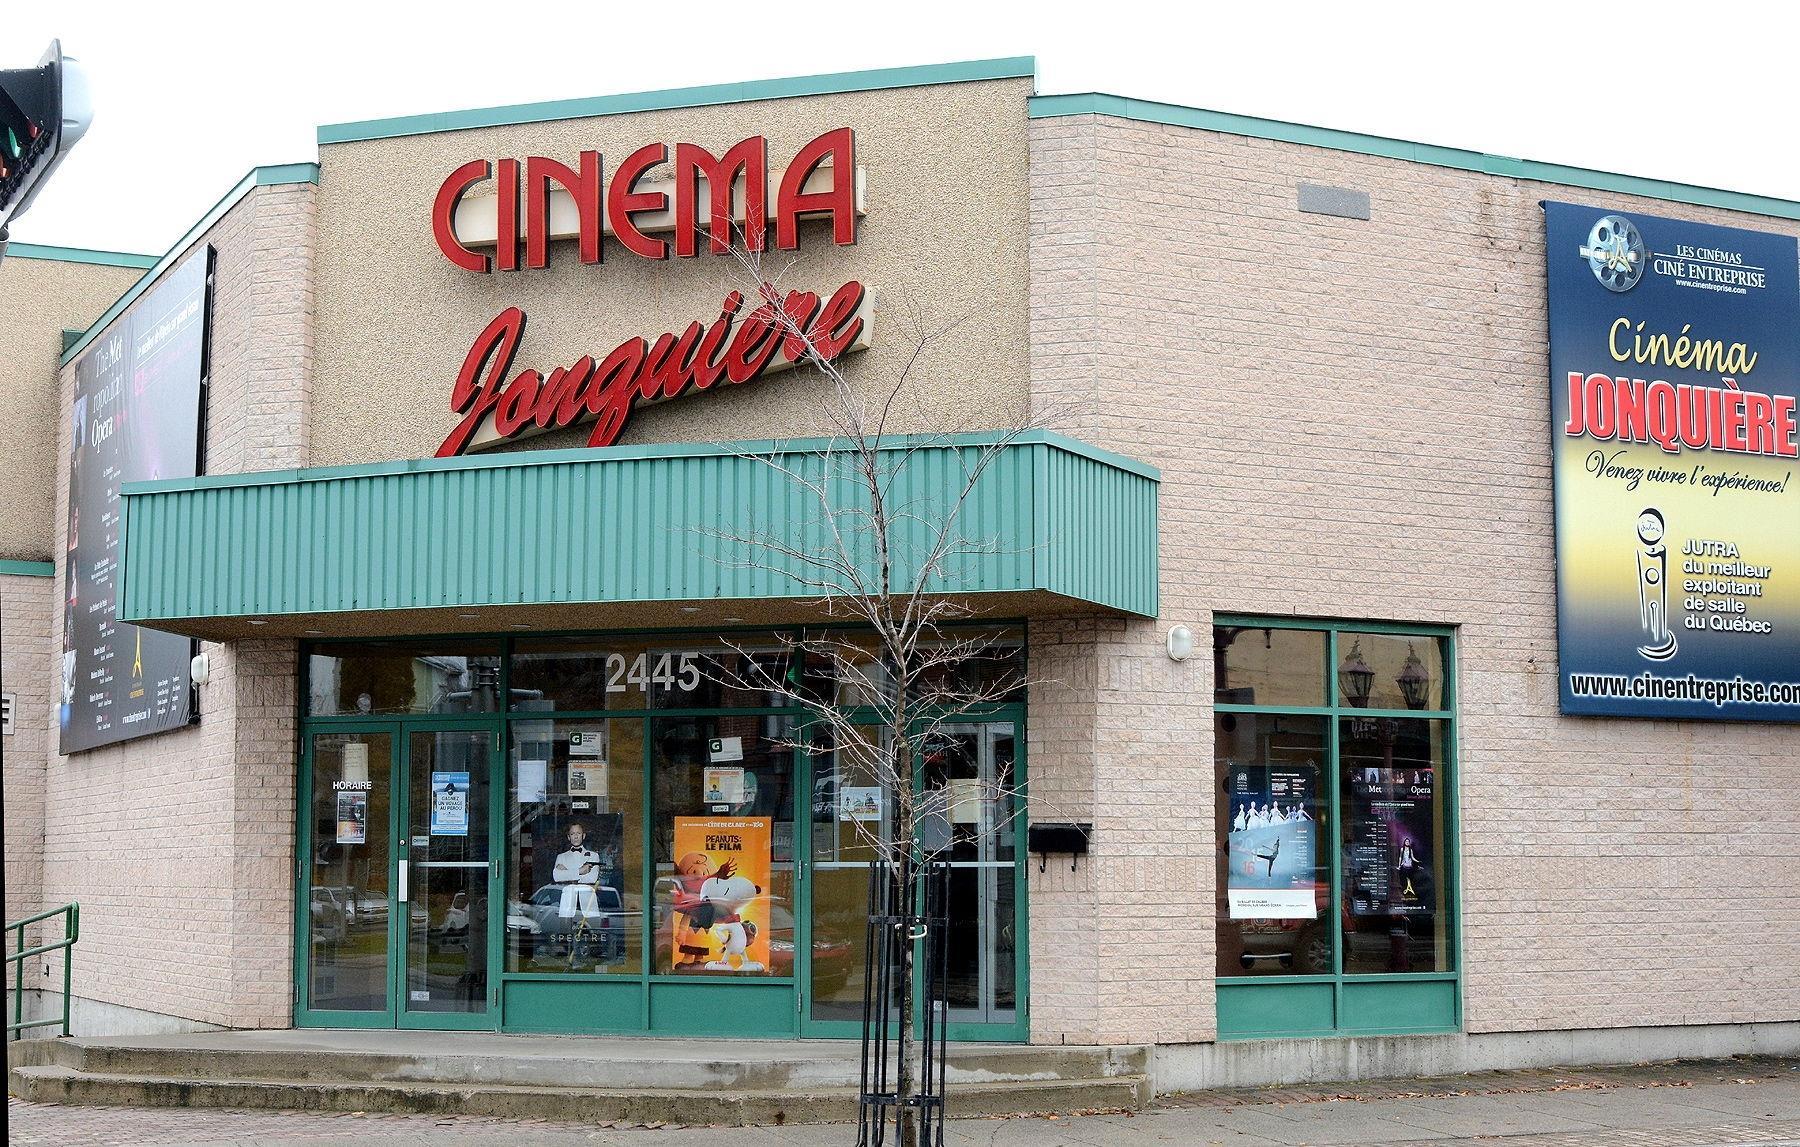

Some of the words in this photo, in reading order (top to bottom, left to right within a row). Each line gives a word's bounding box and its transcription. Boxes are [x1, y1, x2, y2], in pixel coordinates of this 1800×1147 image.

[432, 127, 857, 273] CINEMA
[1676, 245, 1694, 258] LES
[1696, 246, 1742, 265] CINÉMAS
[1654, 258, 1686, 278] CINÉ
[1688, 263, 1766, 289] ENTREPRISE
[1676, 279, 1747, 295] www.cinentreprise.com
[1609, 317, 1758, 374] Cinéma
[1565, 371, 1799, 458] JONQUIÈRE
[91, 416, 114, 454] Opera
[1585, 450, 1644, 491] Venez
[1647, 468, 1687, 485] vivre
[1689, 465, 1791, 496] l'expérience!
[1682, 539, 1740, 558] JUTRA
[1682, 558, 1703, 574] du
[1707, 561, 1771, 579] meilleur
[1682, 577, 1762, 597] exploitant
[1683, 596, 1704, 611] de
[1708, 597, 1746, 614] salle
[1684, 615, 1706, 630] du
[1709, 616, 1772, 634] Québec
[605, 651, 700, 692] 2445
[332, 781, 372, 790] HORAIRE
[1368, 785, 1382, 793] Met
[1411, 786, 1431, 796] Opera
[705, 834, 742, 844] PEANUTS:
[705, 843, 717, 851] LE
[718, 843, 742, 851] FILM
[550, 933, 608, 943] SPECTRE
